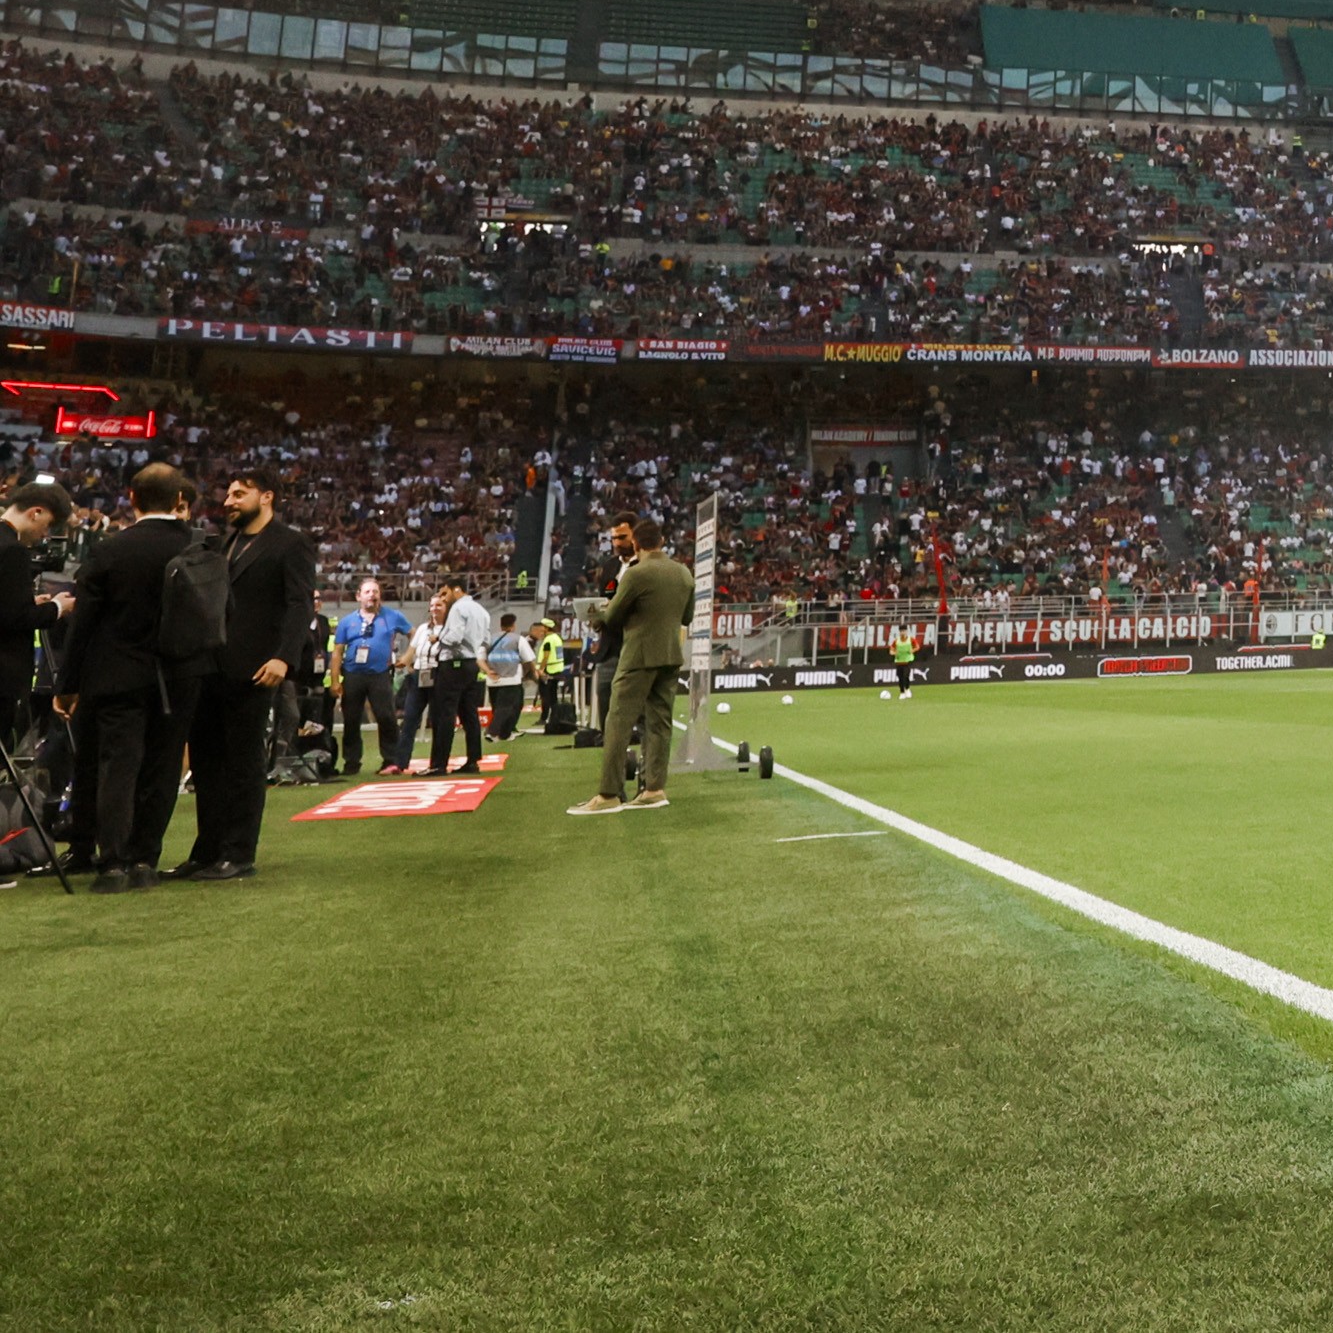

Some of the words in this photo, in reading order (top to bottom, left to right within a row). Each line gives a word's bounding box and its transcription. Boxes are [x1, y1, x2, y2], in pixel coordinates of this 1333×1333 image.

[1, 304, 75, 328] SASSARI
[168, 319, 401, 348] PELTASTI
[907, 350, 957, 361] CRANS
[961, 350, 1032, 362] MONTANA
[1173, 350, 1239, 364] BOLZANO
[717, 614, 753, 636] CLUB
[923, 622, 1028, 645] AADEMY
[950, 665, 991, 680] PUMA
[1025, 664, 1065, 677] 00:00
[715, 674, 757, 689] PUMA
[795, 671, 836, 686] PUMA
